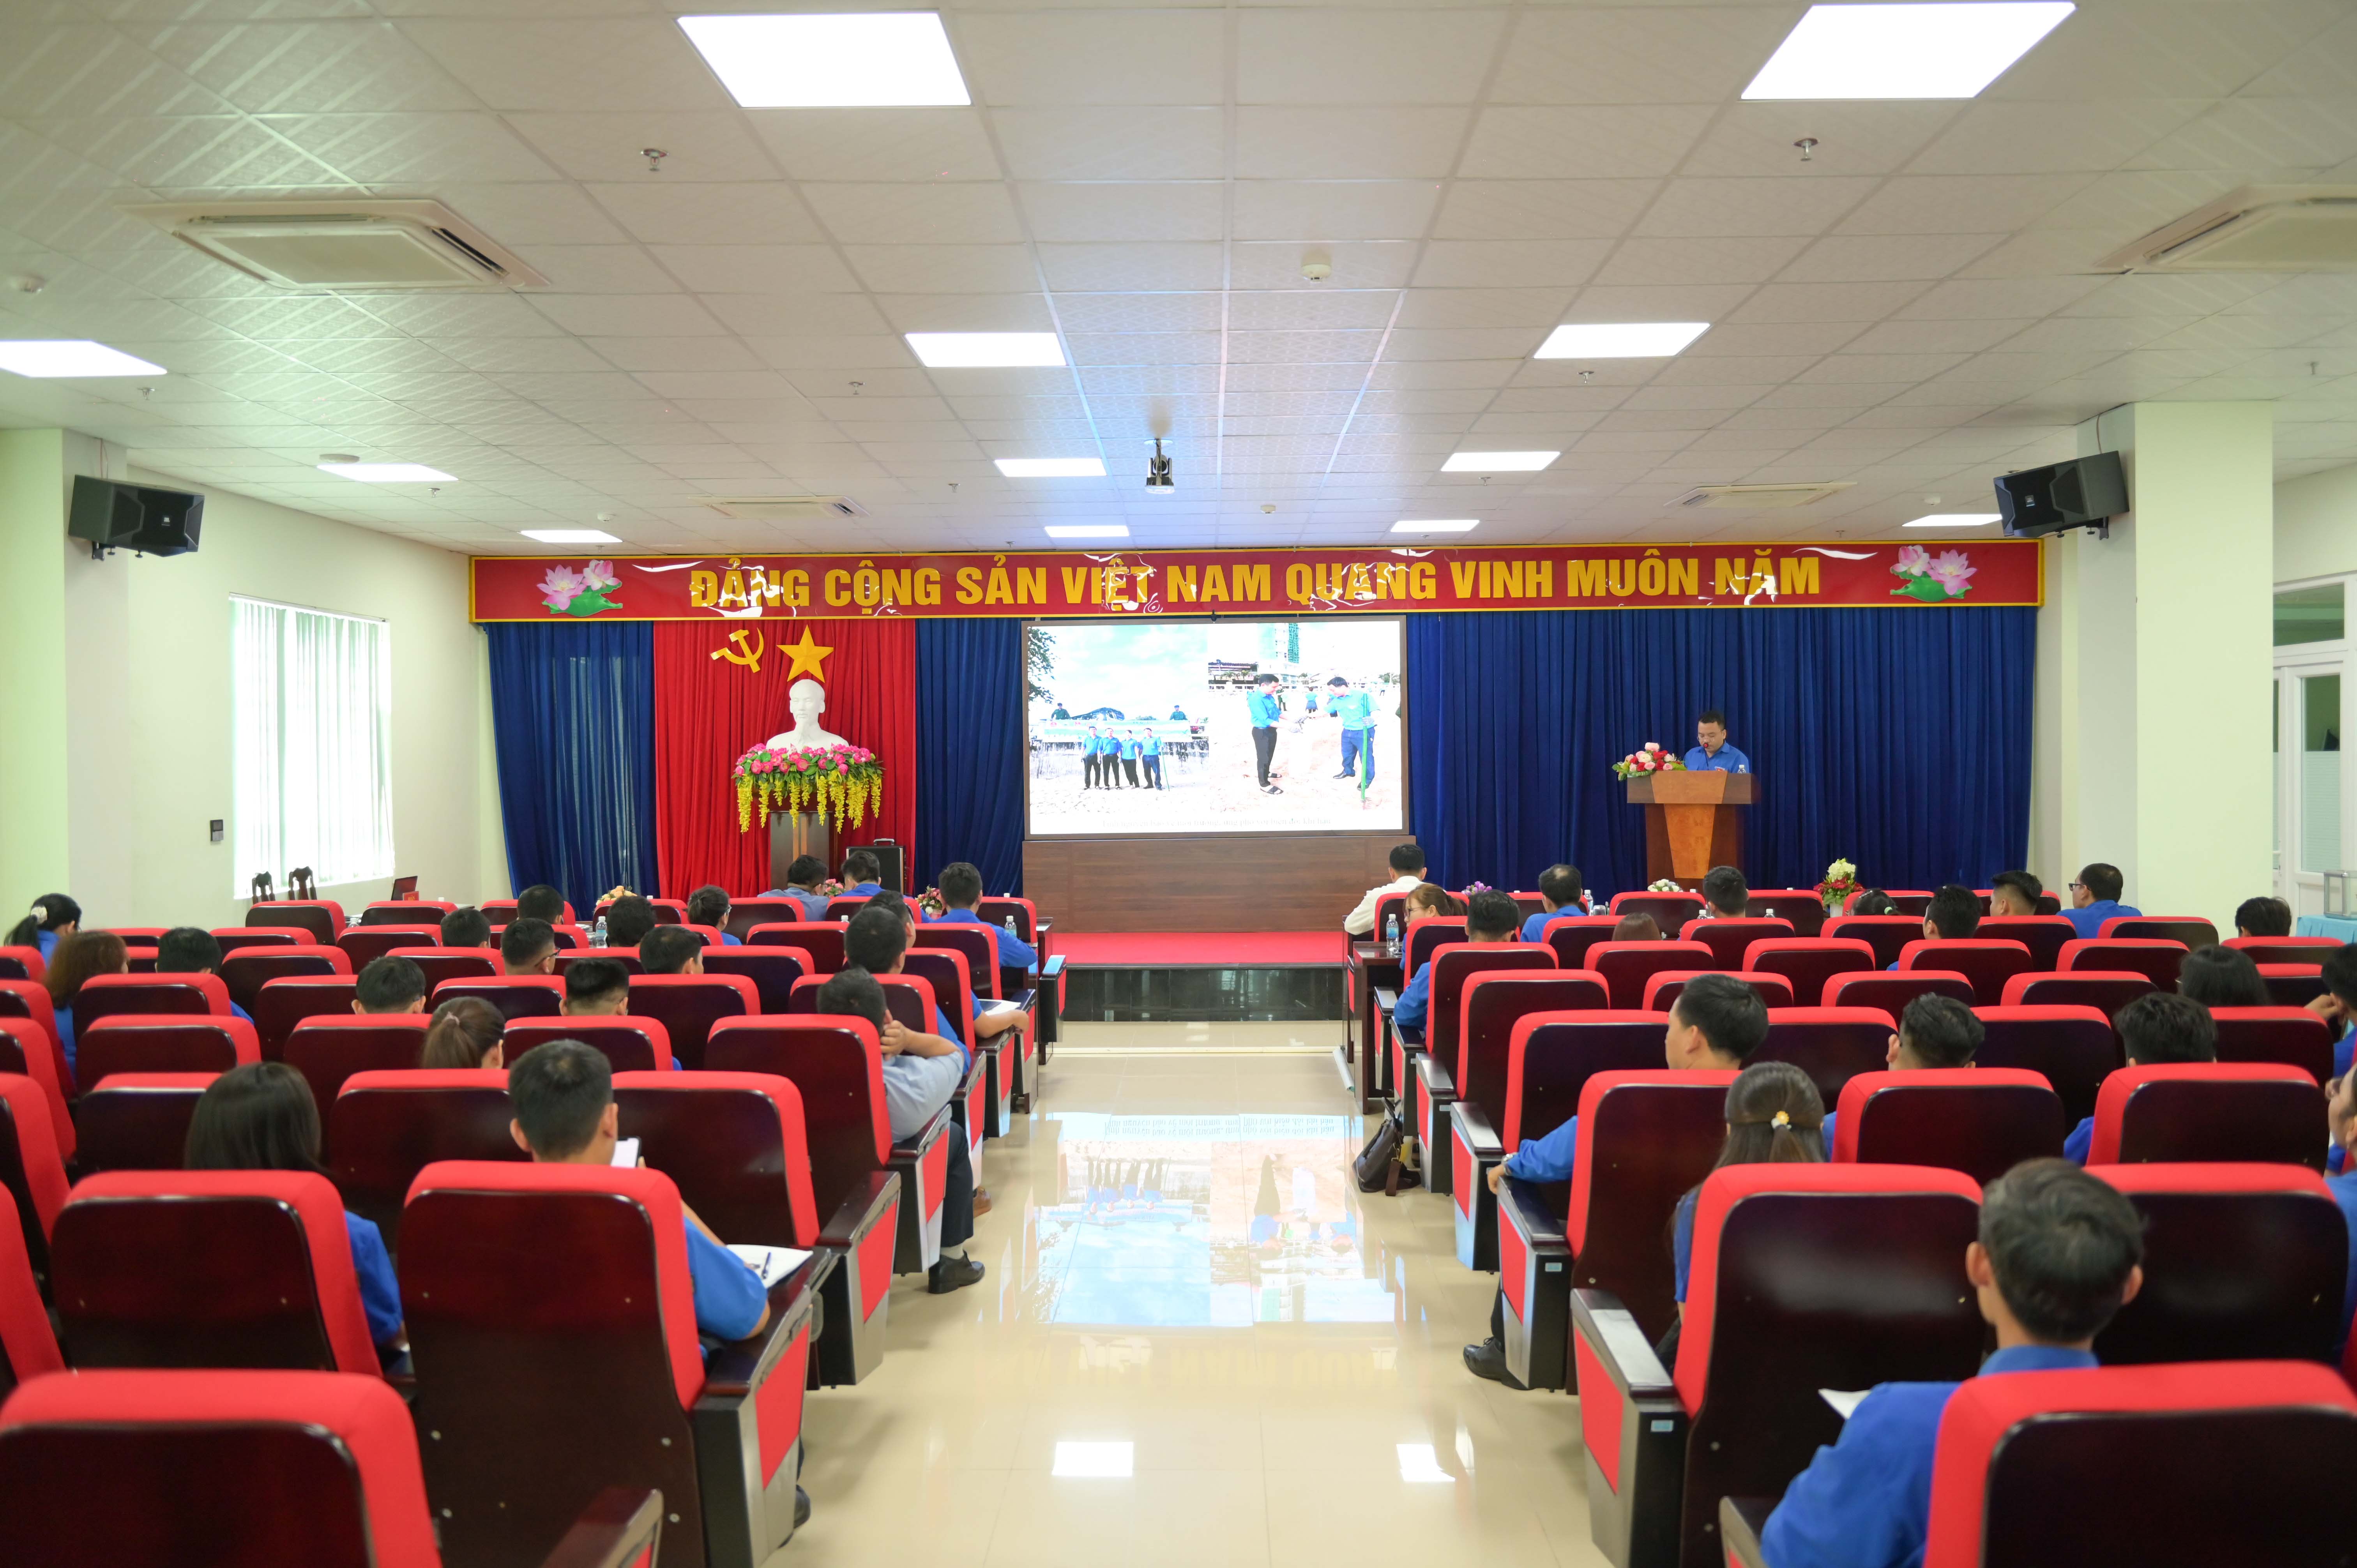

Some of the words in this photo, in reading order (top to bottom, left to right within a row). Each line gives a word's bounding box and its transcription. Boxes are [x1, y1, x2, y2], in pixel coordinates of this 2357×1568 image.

[689, 558, 809, 607] ĐẢNG
[825, 560, 941, 614] CỘNG
[956, 554, 1046, 604] SẢN
[1061, 558, 1154, 611] VIỆT
[1168, 564, 1270, 602] NAM
[1286, 562, 1436, 605] QUANG
[1450, 561, 1553, 599] VINH
[1567, 549, 1698, 597] MUÔN
[1715, 548, 1819, 595] NĂM
